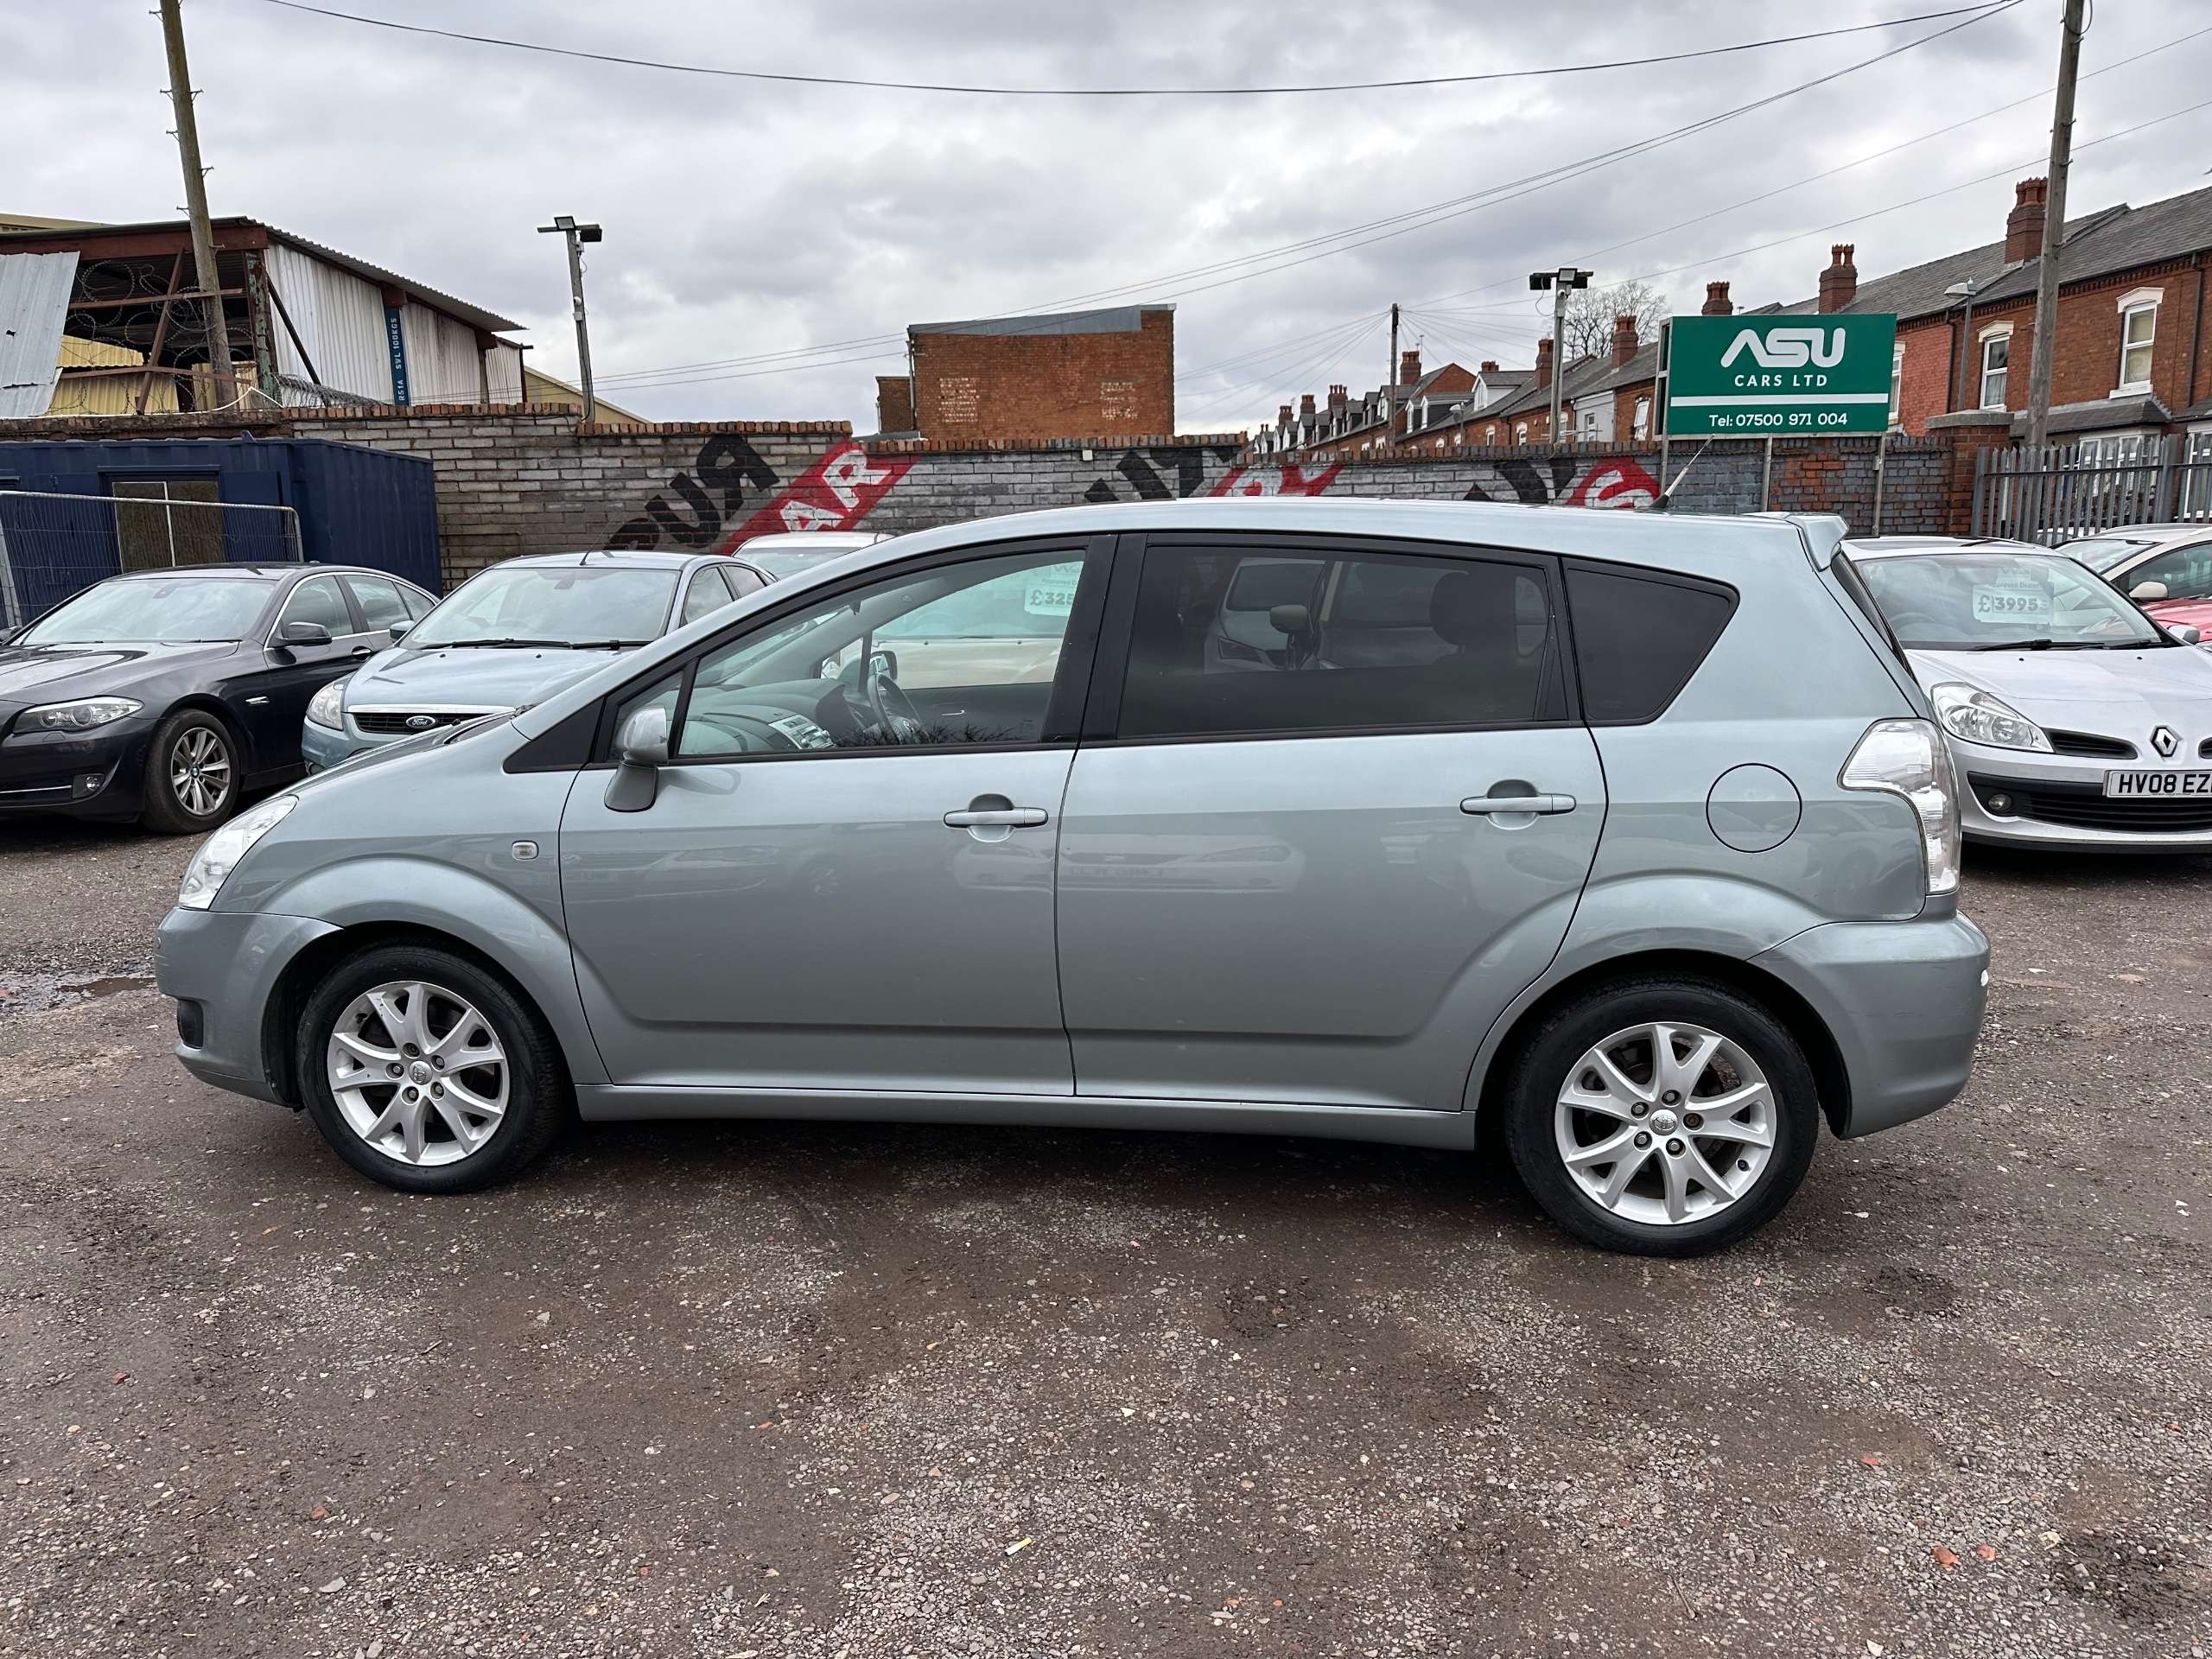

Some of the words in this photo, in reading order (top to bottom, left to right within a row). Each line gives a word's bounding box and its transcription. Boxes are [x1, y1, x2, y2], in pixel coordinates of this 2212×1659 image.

[1720, 327, 1847, 368] ASU
[1734, 374, 1783, 387] CARS
[1793, 374, 1827, 387] LTD
[1788, 413, 1812, 426] 971
[1817, 412, 1848, 425] 004
[2118, 773, 2177, 793] HV08
[2183, 773, 2212, 793] EZ
